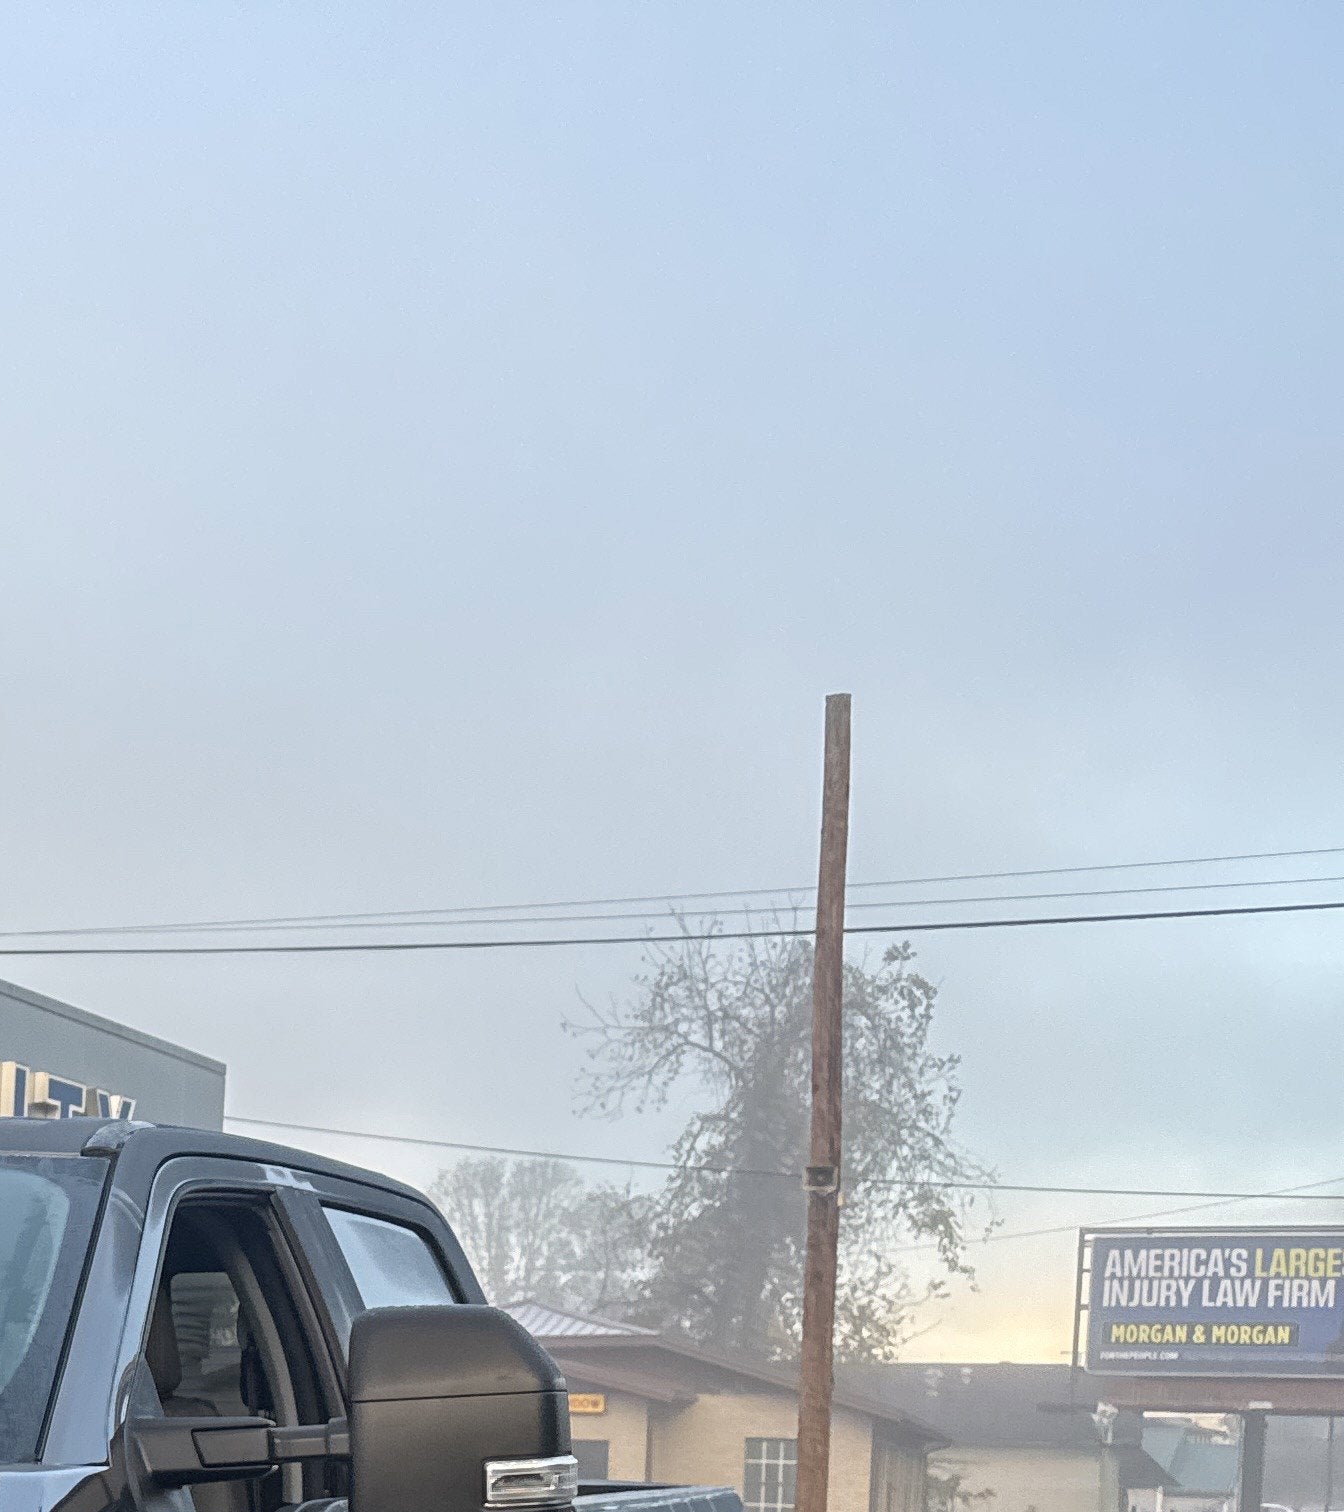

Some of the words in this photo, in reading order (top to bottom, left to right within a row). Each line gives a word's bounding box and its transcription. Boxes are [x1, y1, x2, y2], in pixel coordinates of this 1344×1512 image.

[1104, 1247, 1248, 1278] AMERICA'S
[1254, 1247, 1344, 1278] LARGE
[1102, 1279, 1196, 1308] INJURY
[1201, 1279, 1261, 1308] LAW
[1267, 1279, 1336, 1308] FIRM
[1111, 1325, 1187, 1344] MORGAN
[1192, 1326, 1206, 1344] &
[1211, 1326, 1291, 1345] MORGAN
